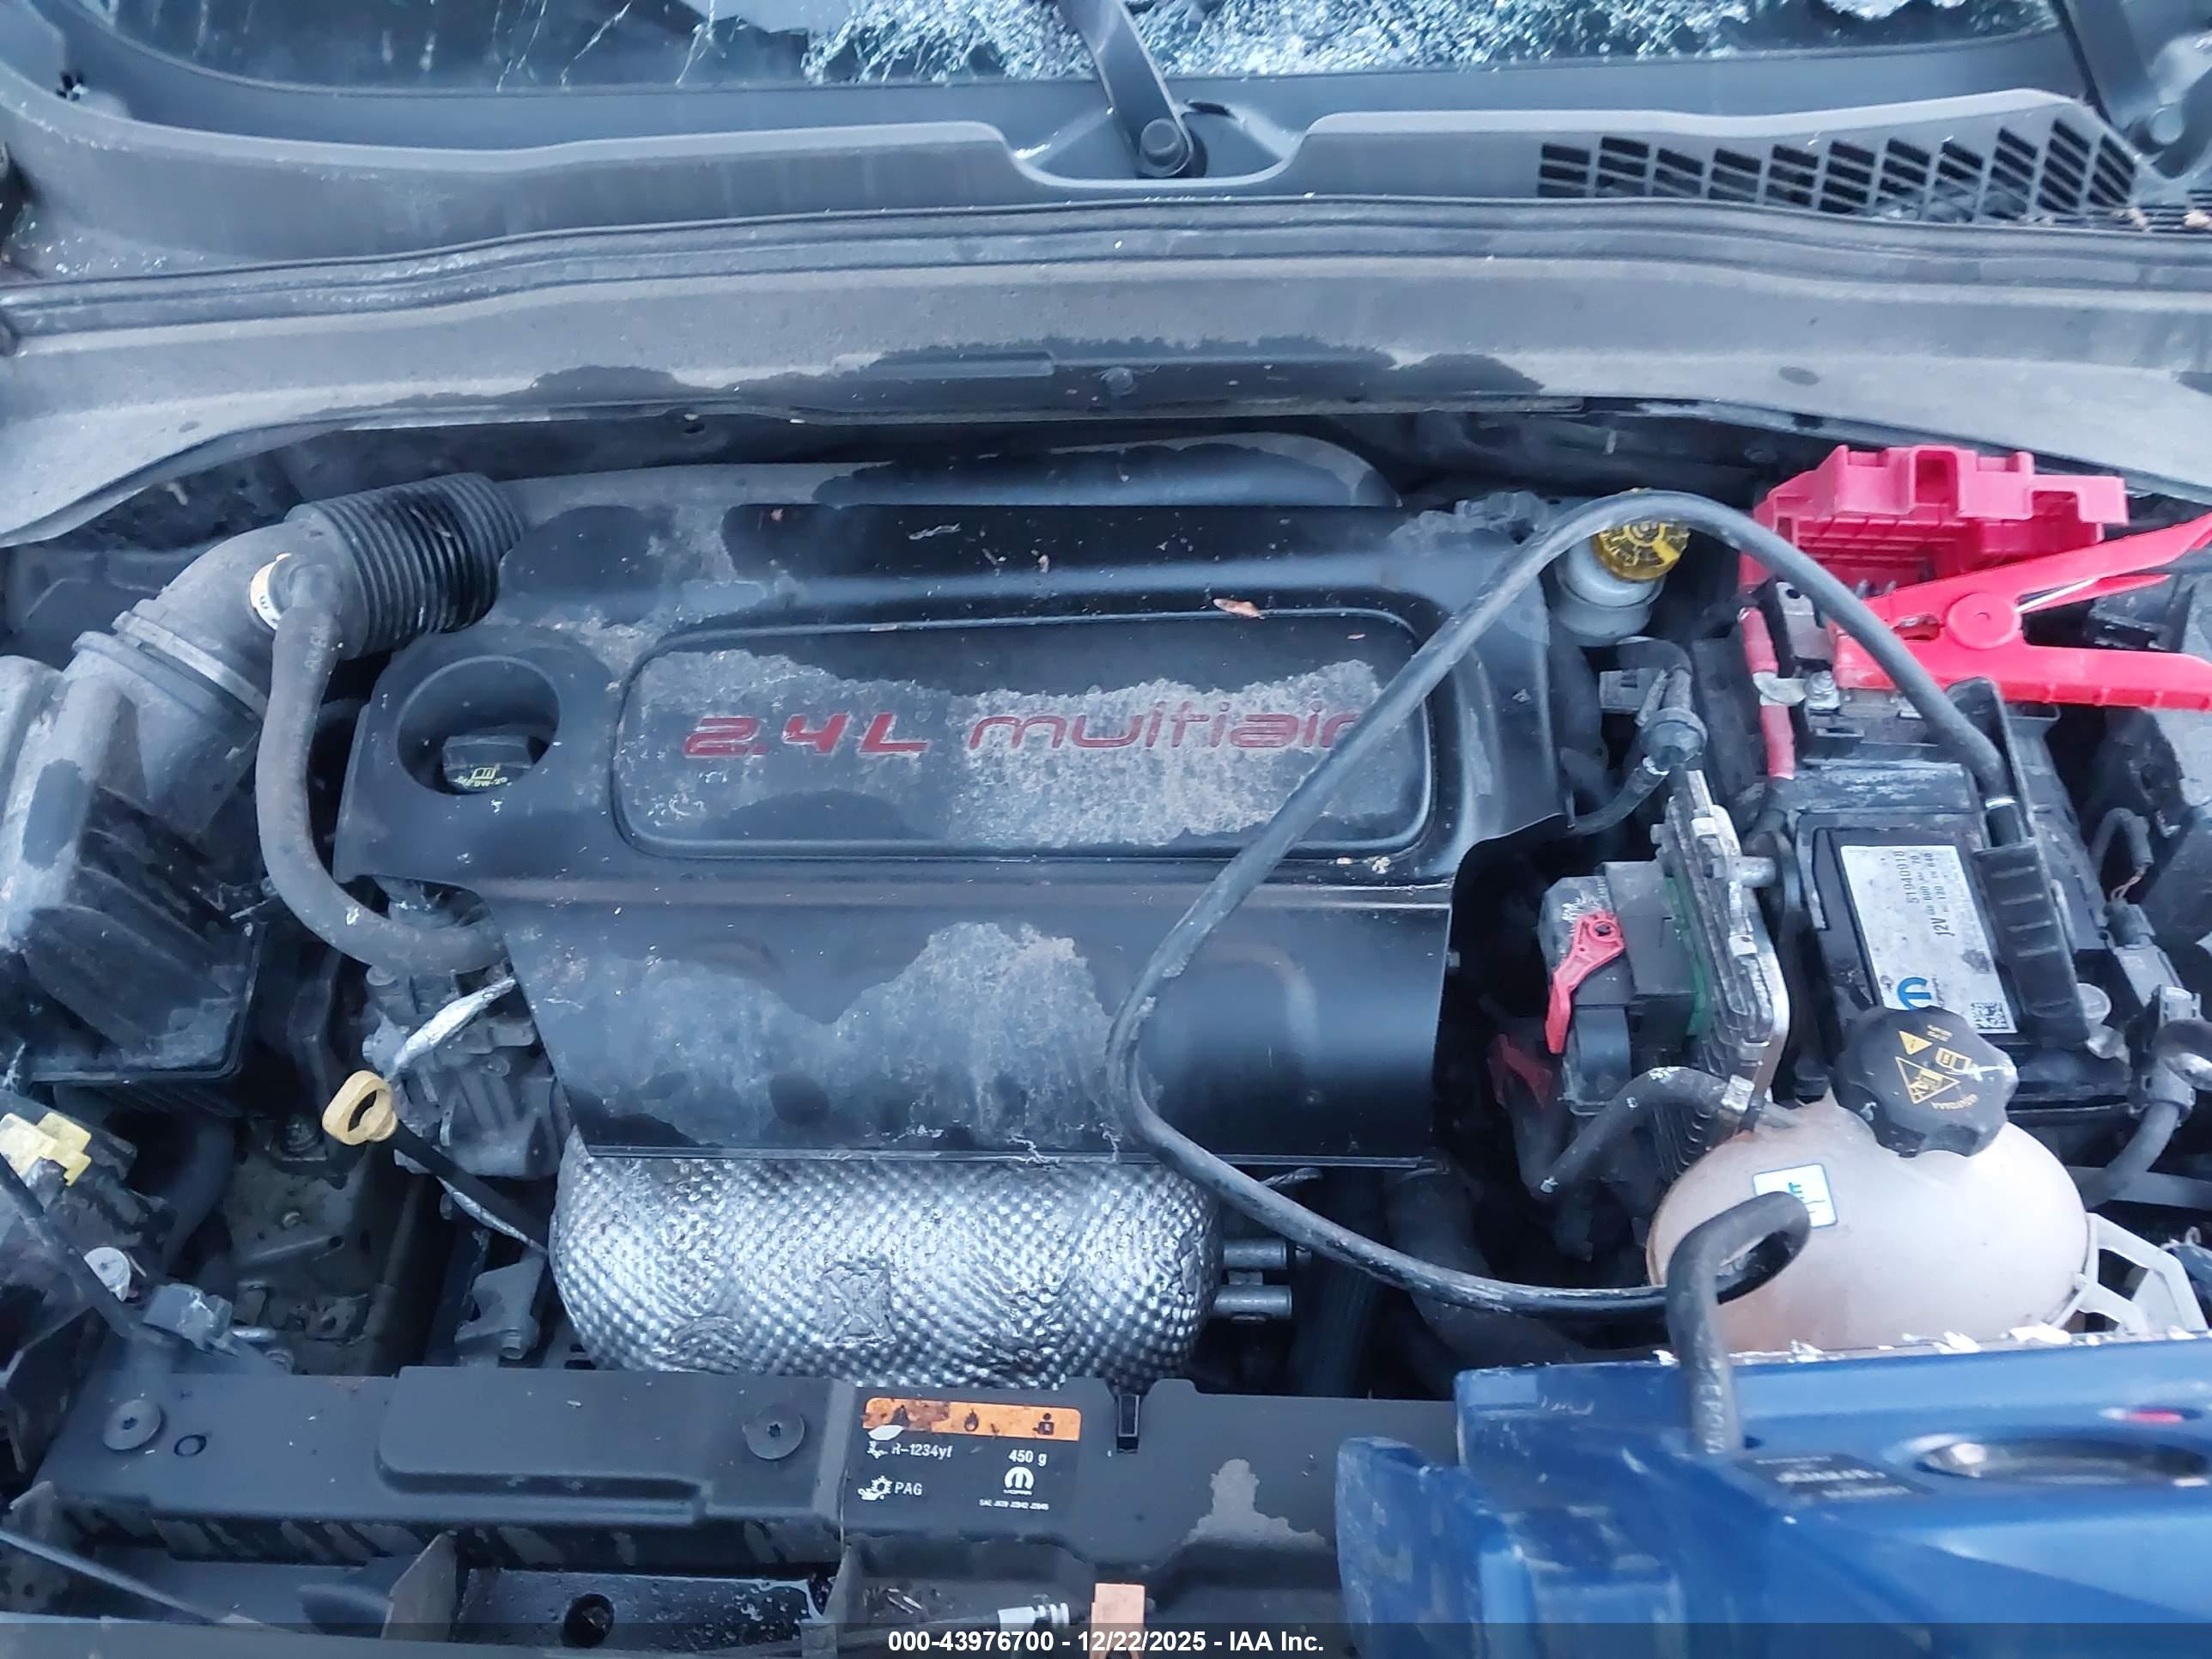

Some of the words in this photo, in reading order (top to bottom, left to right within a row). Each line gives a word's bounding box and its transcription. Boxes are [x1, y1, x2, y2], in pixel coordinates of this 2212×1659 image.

[684, 711, 929, 757] 2.4L
[968, 701, 1361, 749] multiair
[891, 1443, 953, 1460] R-1234yf
[1008, 1449, 1034, 1463] 450
[1037, 1453, 1048, 1467] g
[894, 1481, 923, 1496] PAG
